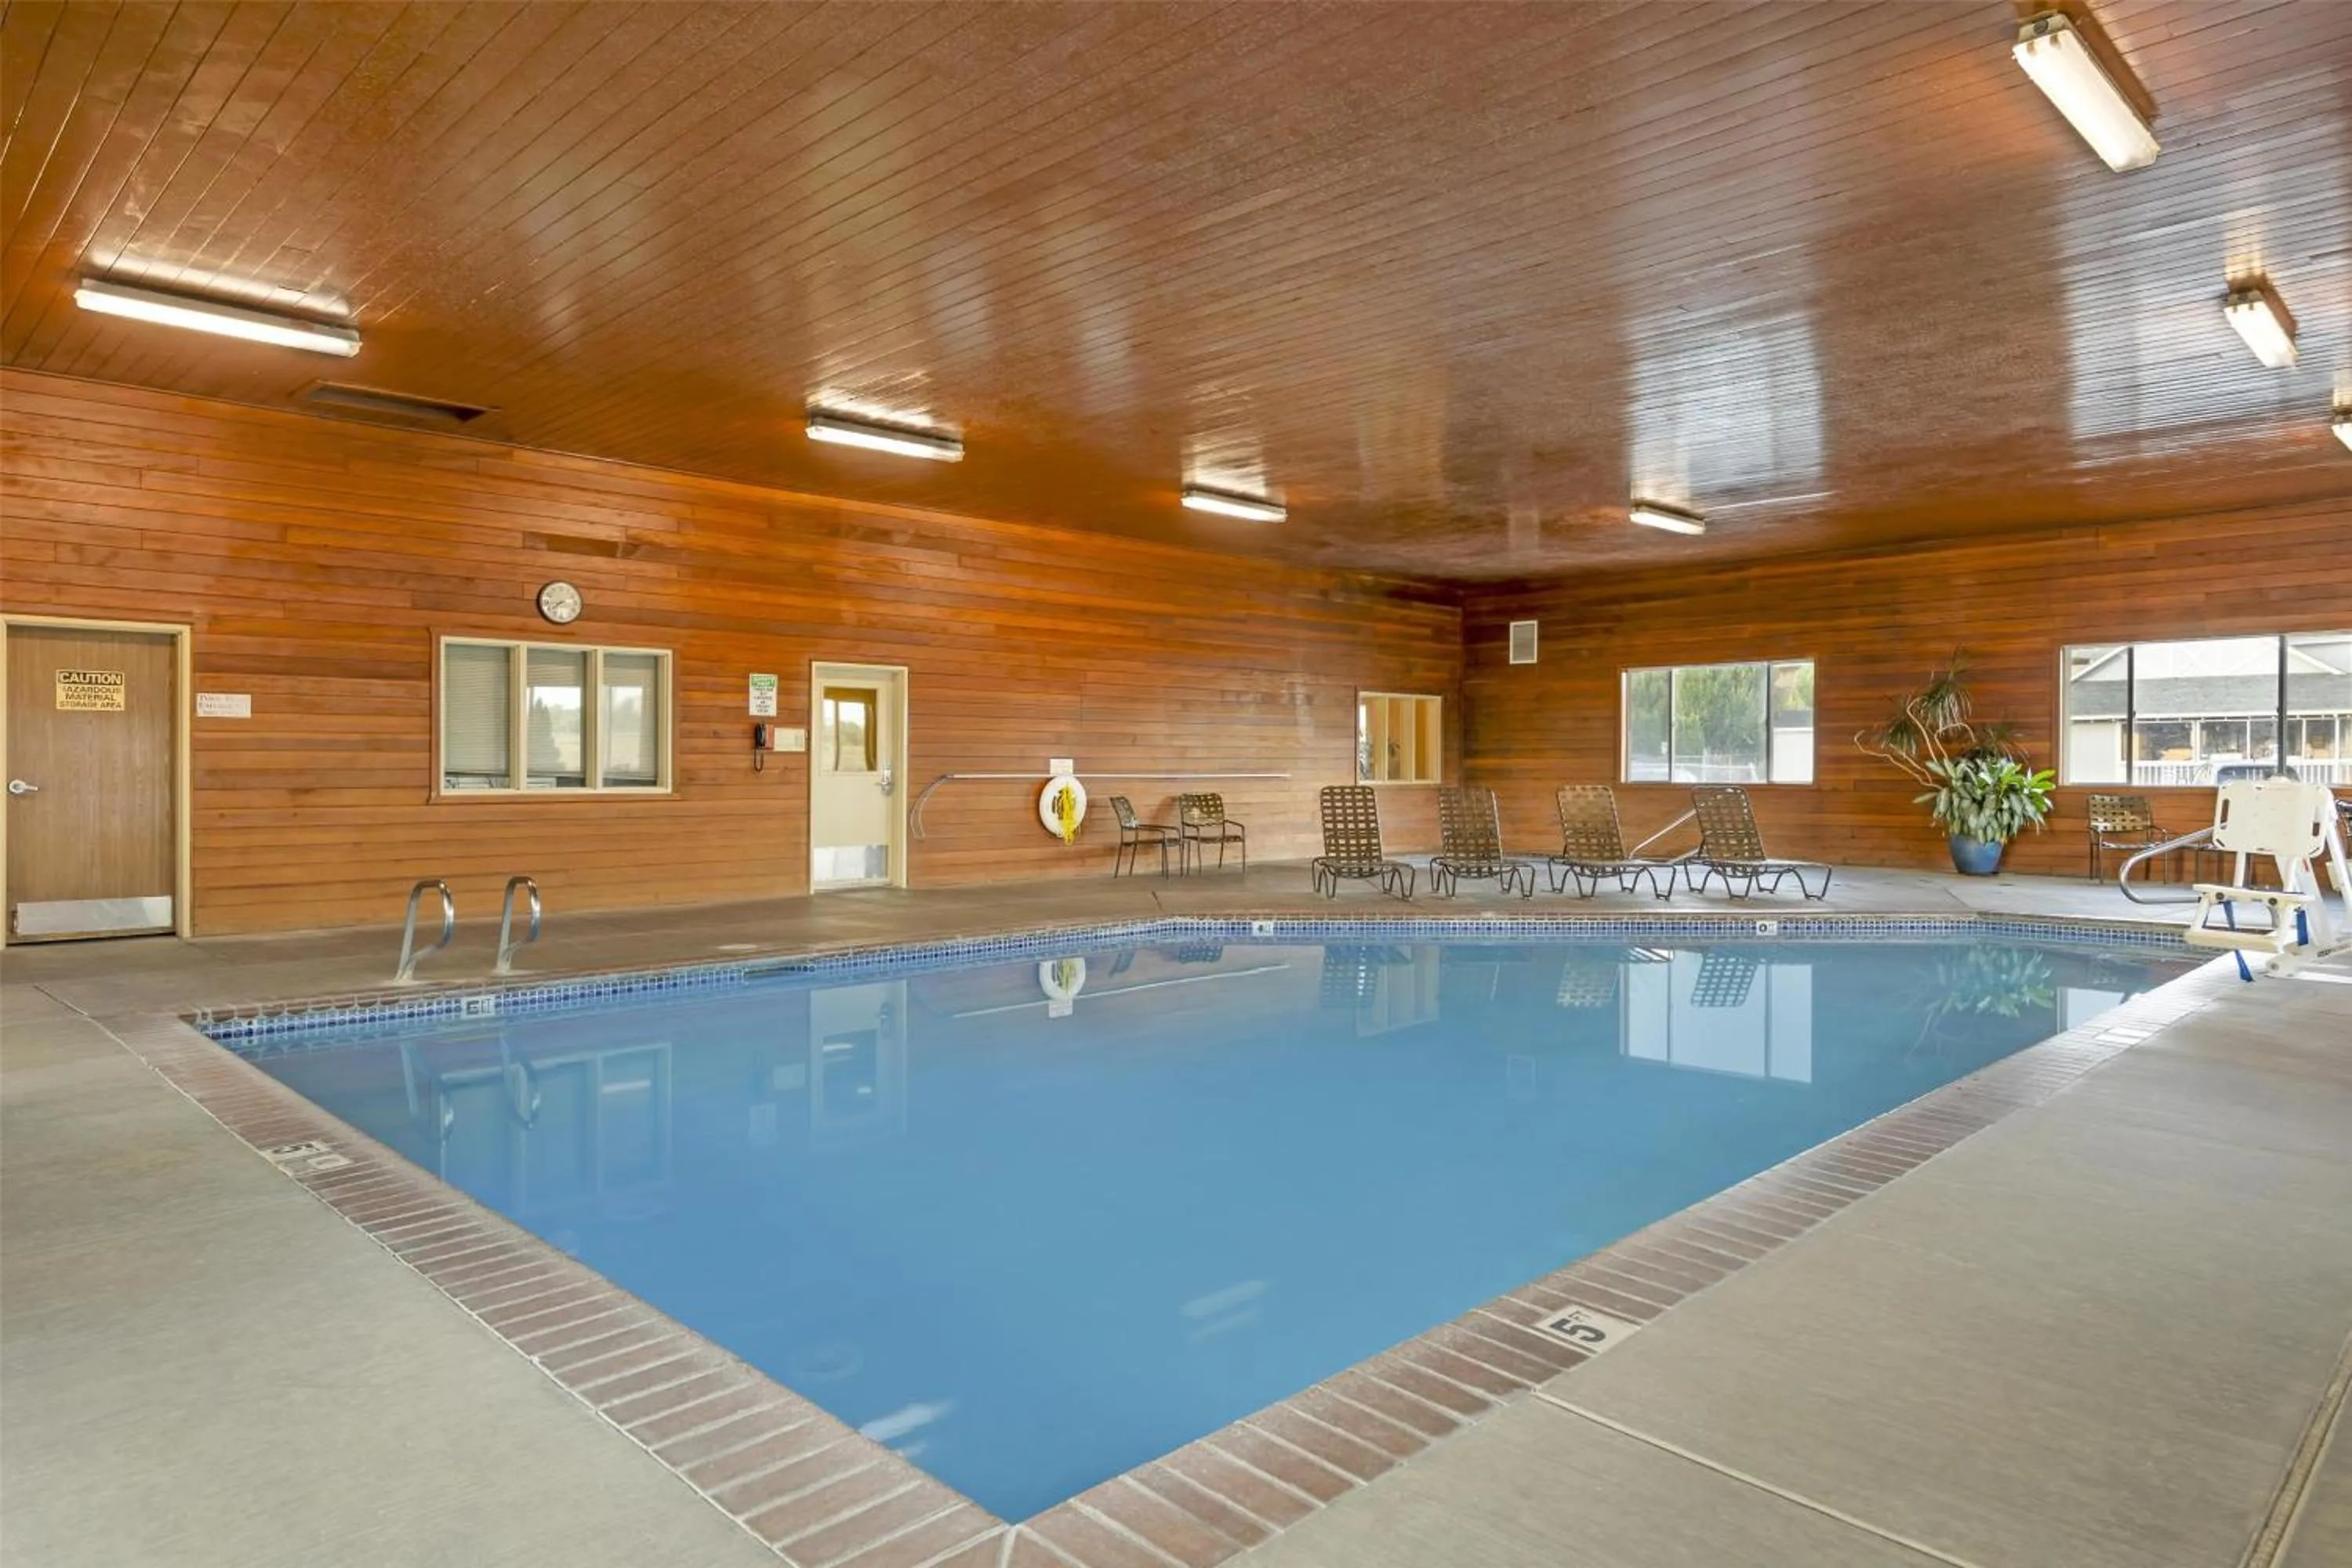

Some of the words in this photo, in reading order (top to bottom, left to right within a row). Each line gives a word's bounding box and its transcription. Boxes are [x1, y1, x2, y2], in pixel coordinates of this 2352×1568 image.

[60, 672, 122, 684] CAUTION
[65, 693, 117, 702] MATERIAL
[1549, 1318, 1606, 1343] 5
